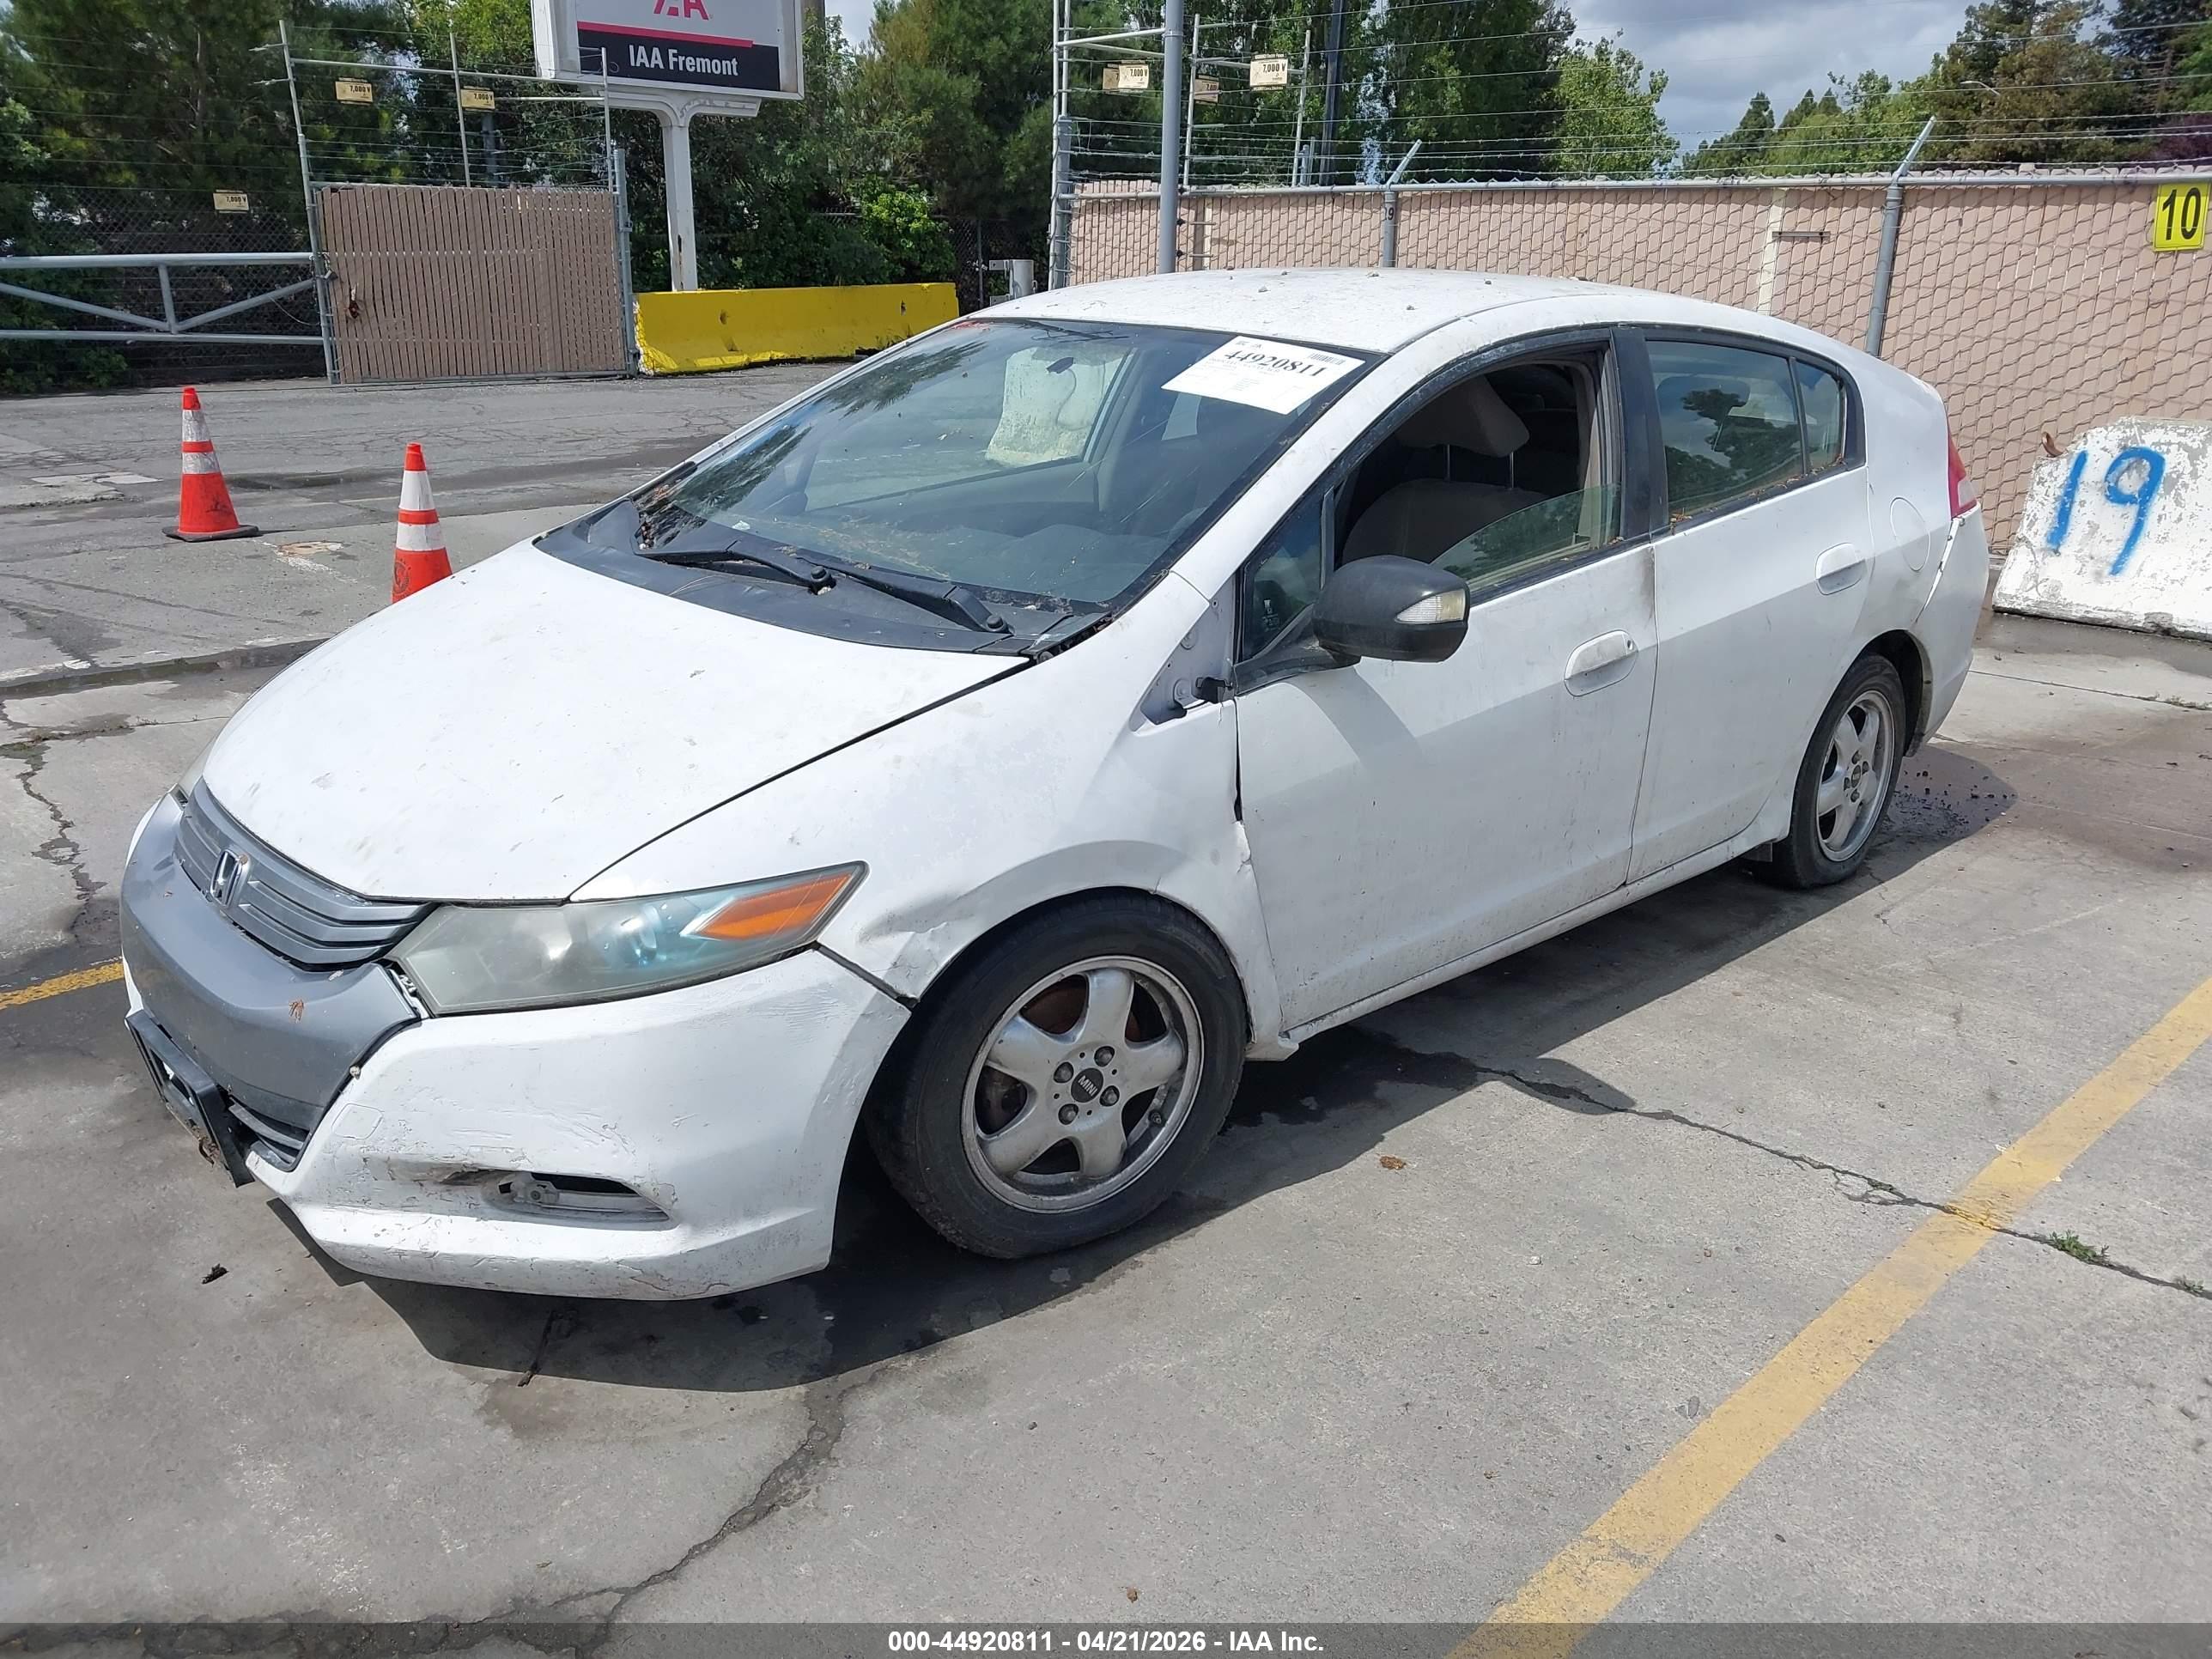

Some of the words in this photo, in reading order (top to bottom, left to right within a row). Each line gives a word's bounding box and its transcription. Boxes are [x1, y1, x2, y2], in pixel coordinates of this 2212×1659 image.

[629, 44, 665, 70] IAA
[668, 49, 738, 76] Fremont
[1263, 64, 1280, 73] 7,000
[2162, 187, 2202, 241] 10
[1224, 349, 1328, 377] 44920811
[2046, 446, 2166, 576] 19
[1078, 1075, 1098, 1097] MINI
